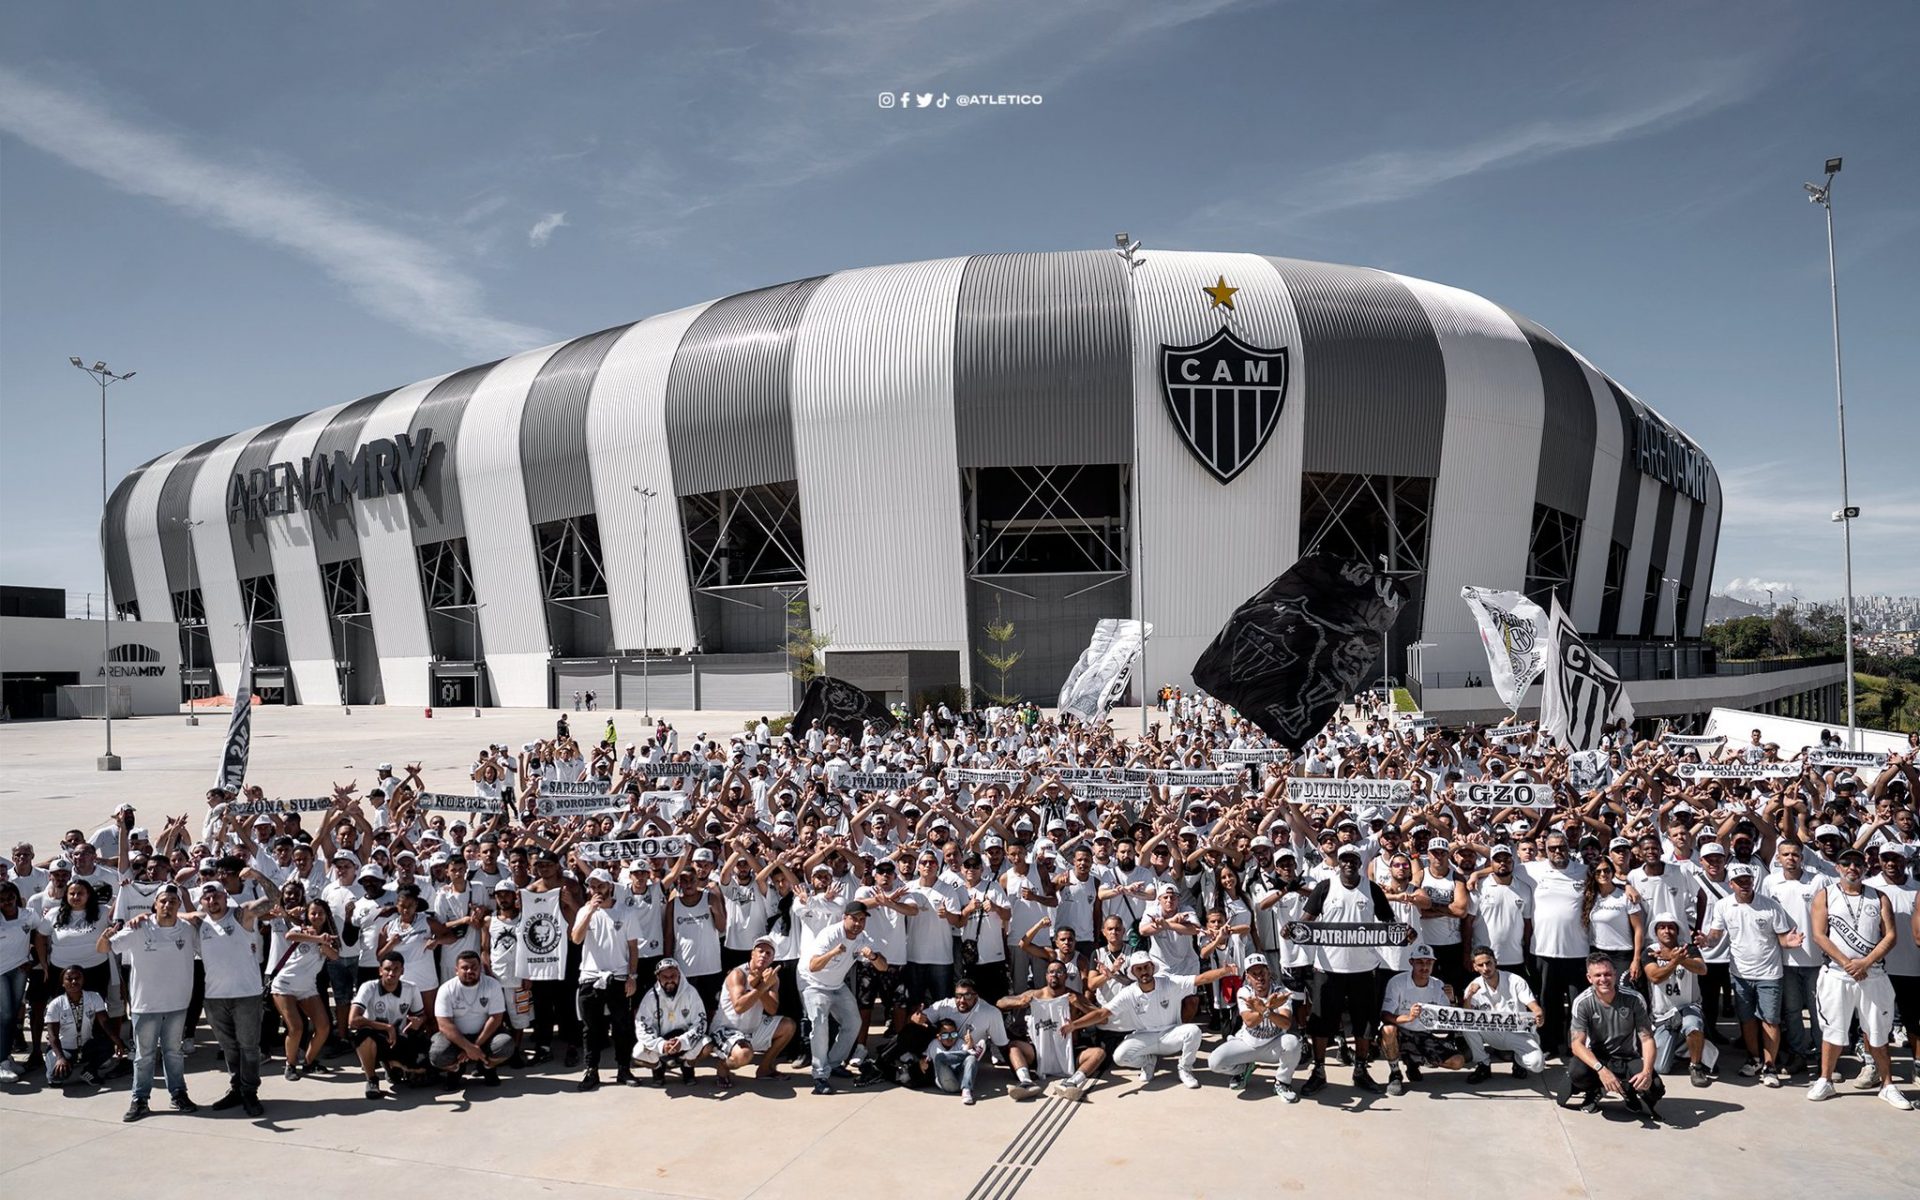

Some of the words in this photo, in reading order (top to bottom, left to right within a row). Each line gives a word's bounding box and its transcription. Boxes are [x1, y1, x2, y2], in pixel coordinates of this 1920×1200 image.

[1180, 358, 1268, 383] CAM
[1826, 751, 1875, 761] CURVELO
[645, 763, 691, 777] SARZEDO
[549, 781, 597, 794] SARZEDO
[852, 777, 907, 789] ITABIRA
[1304, 780, 1391, 799] DIVINÓPOLIS
[1468, 784, 1535, 805] GZO
[289, 798, 317, 812] SUL
[435, 795, 486, 809] NORTE
[556, 797, 610, 809] NOROESTE
[598, 839, 661, 860] GNO
[1312, 926, 1387, 945] PATRIMÔNIO
[1665, 983, 1681, 996] 84
